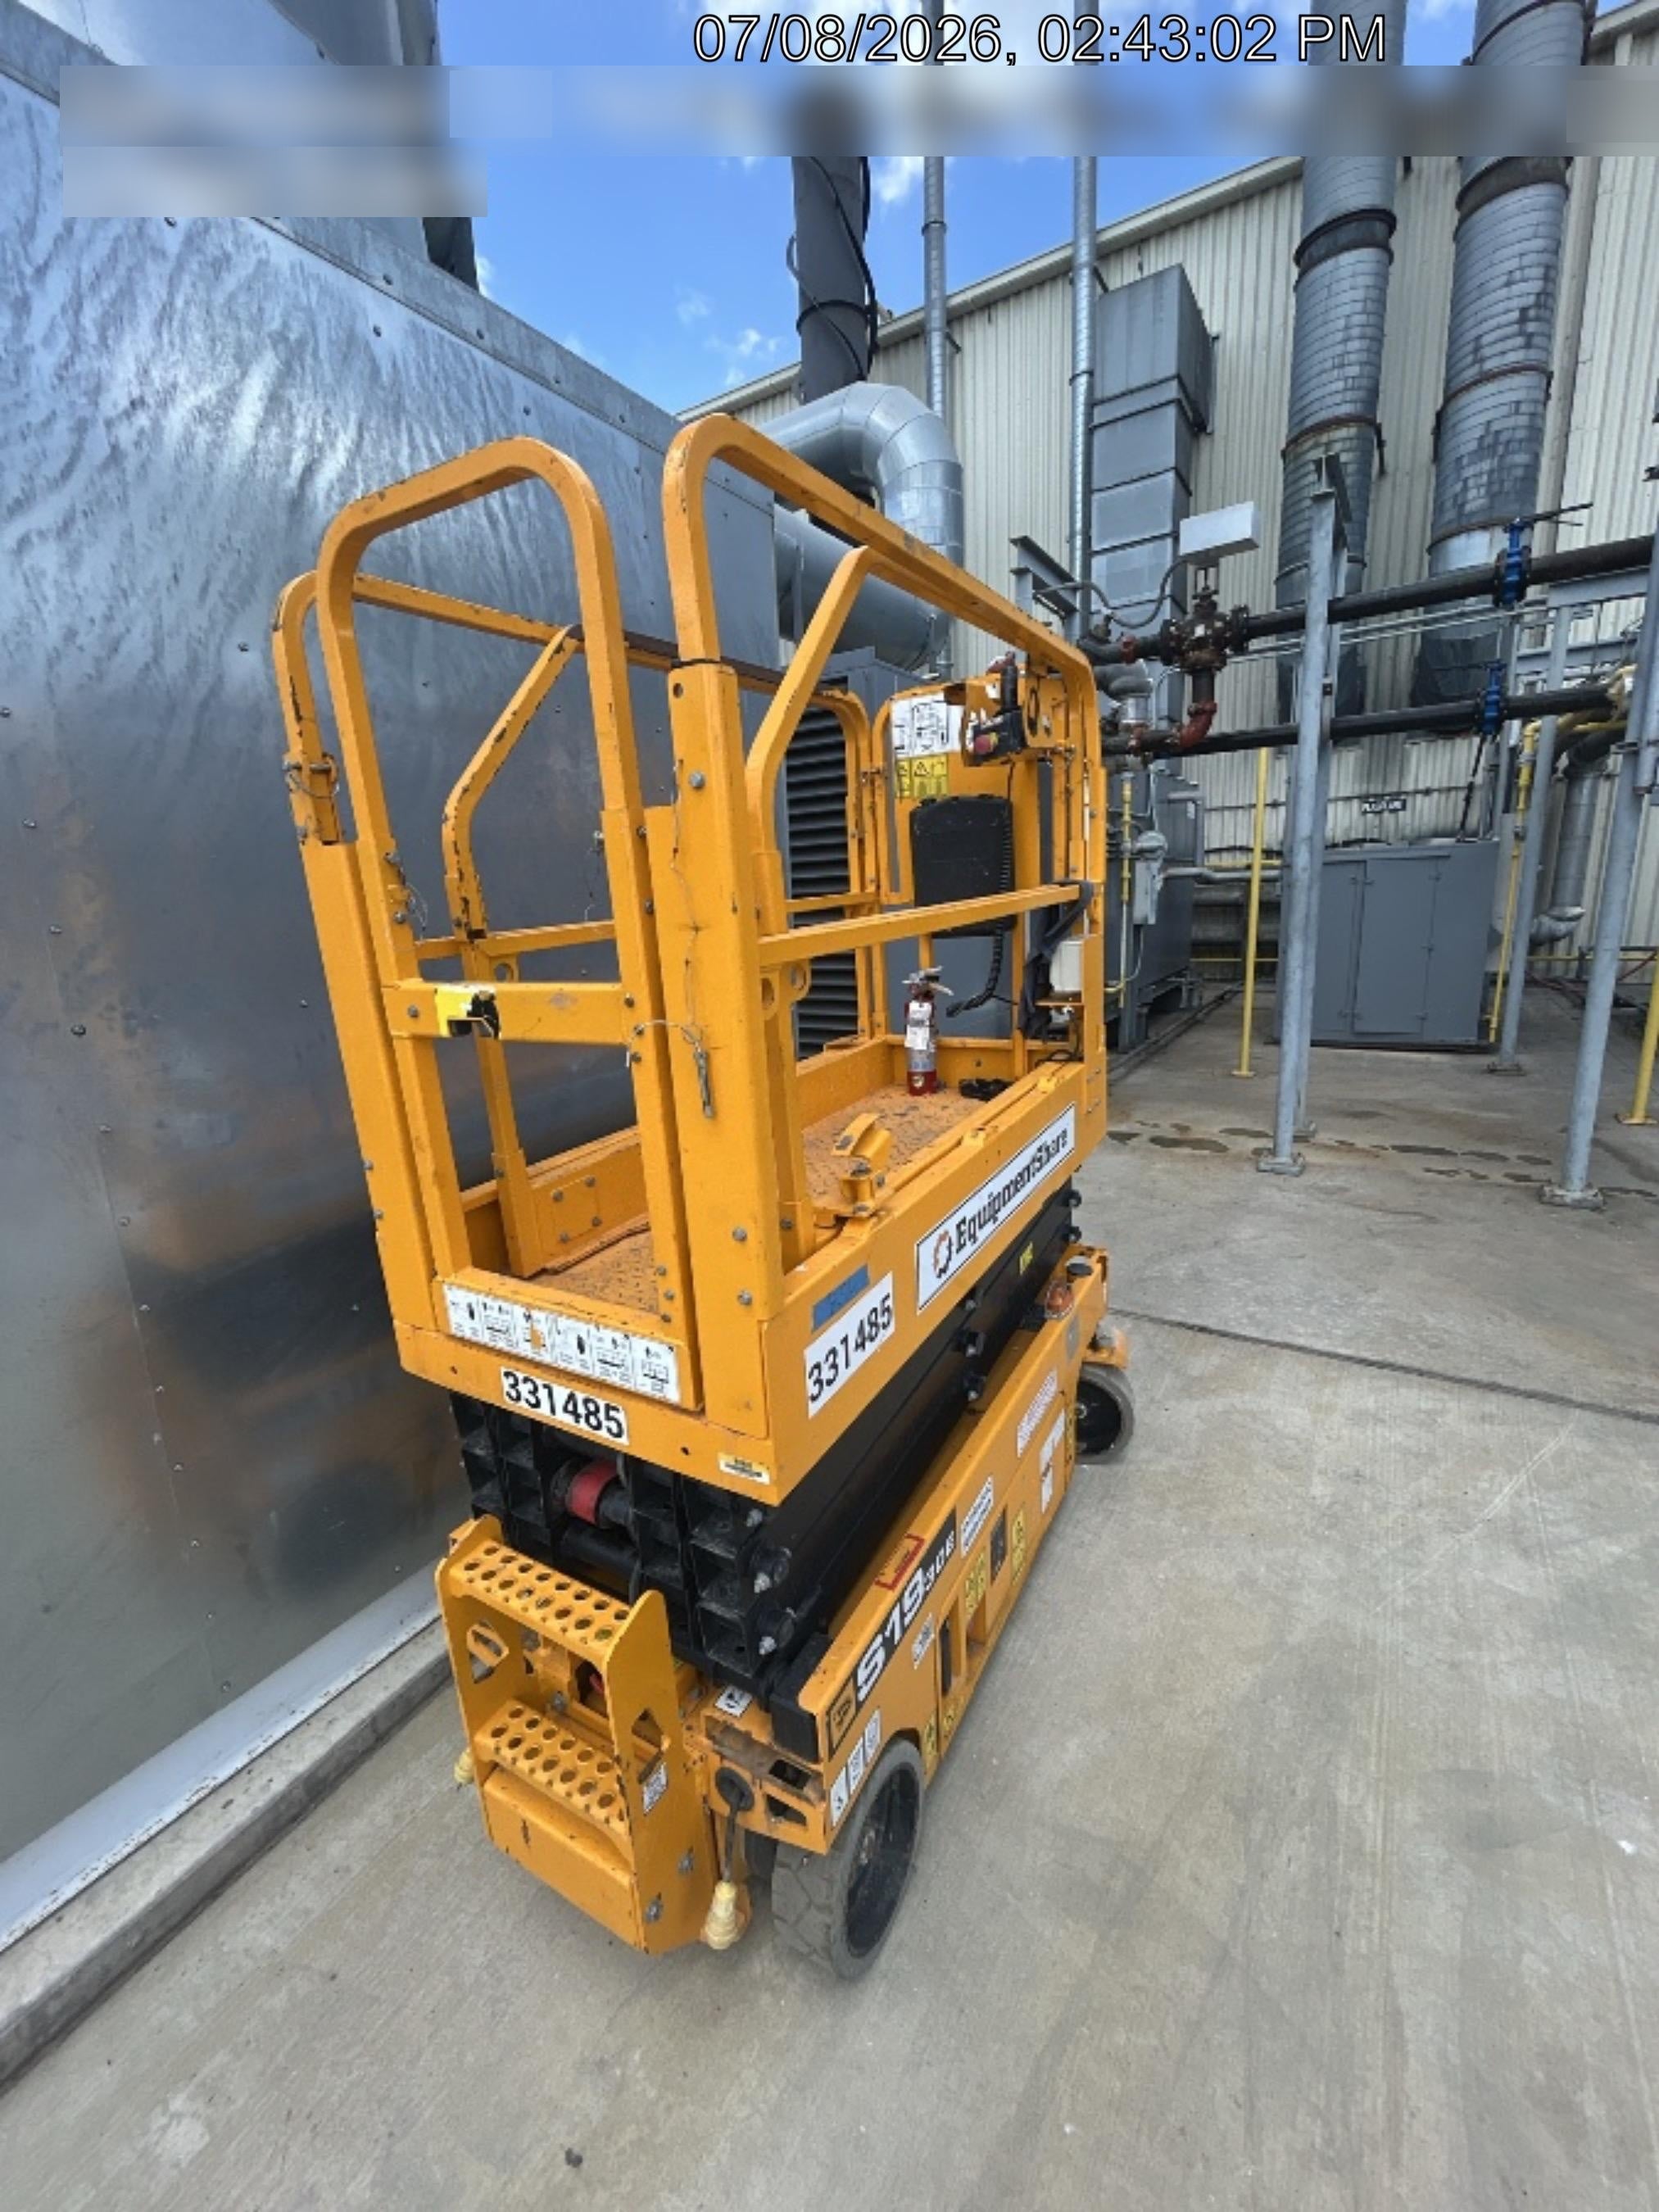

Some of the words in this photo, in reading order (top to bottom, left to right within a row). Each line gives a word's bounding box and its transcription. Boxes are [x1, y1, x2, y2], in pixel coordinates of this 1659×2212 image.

[956, 1127, 1067, 1253] EquipmentShare
[808, 1292, 891, 1403] 331485
[501, 1371, 625, 1440] 331485
